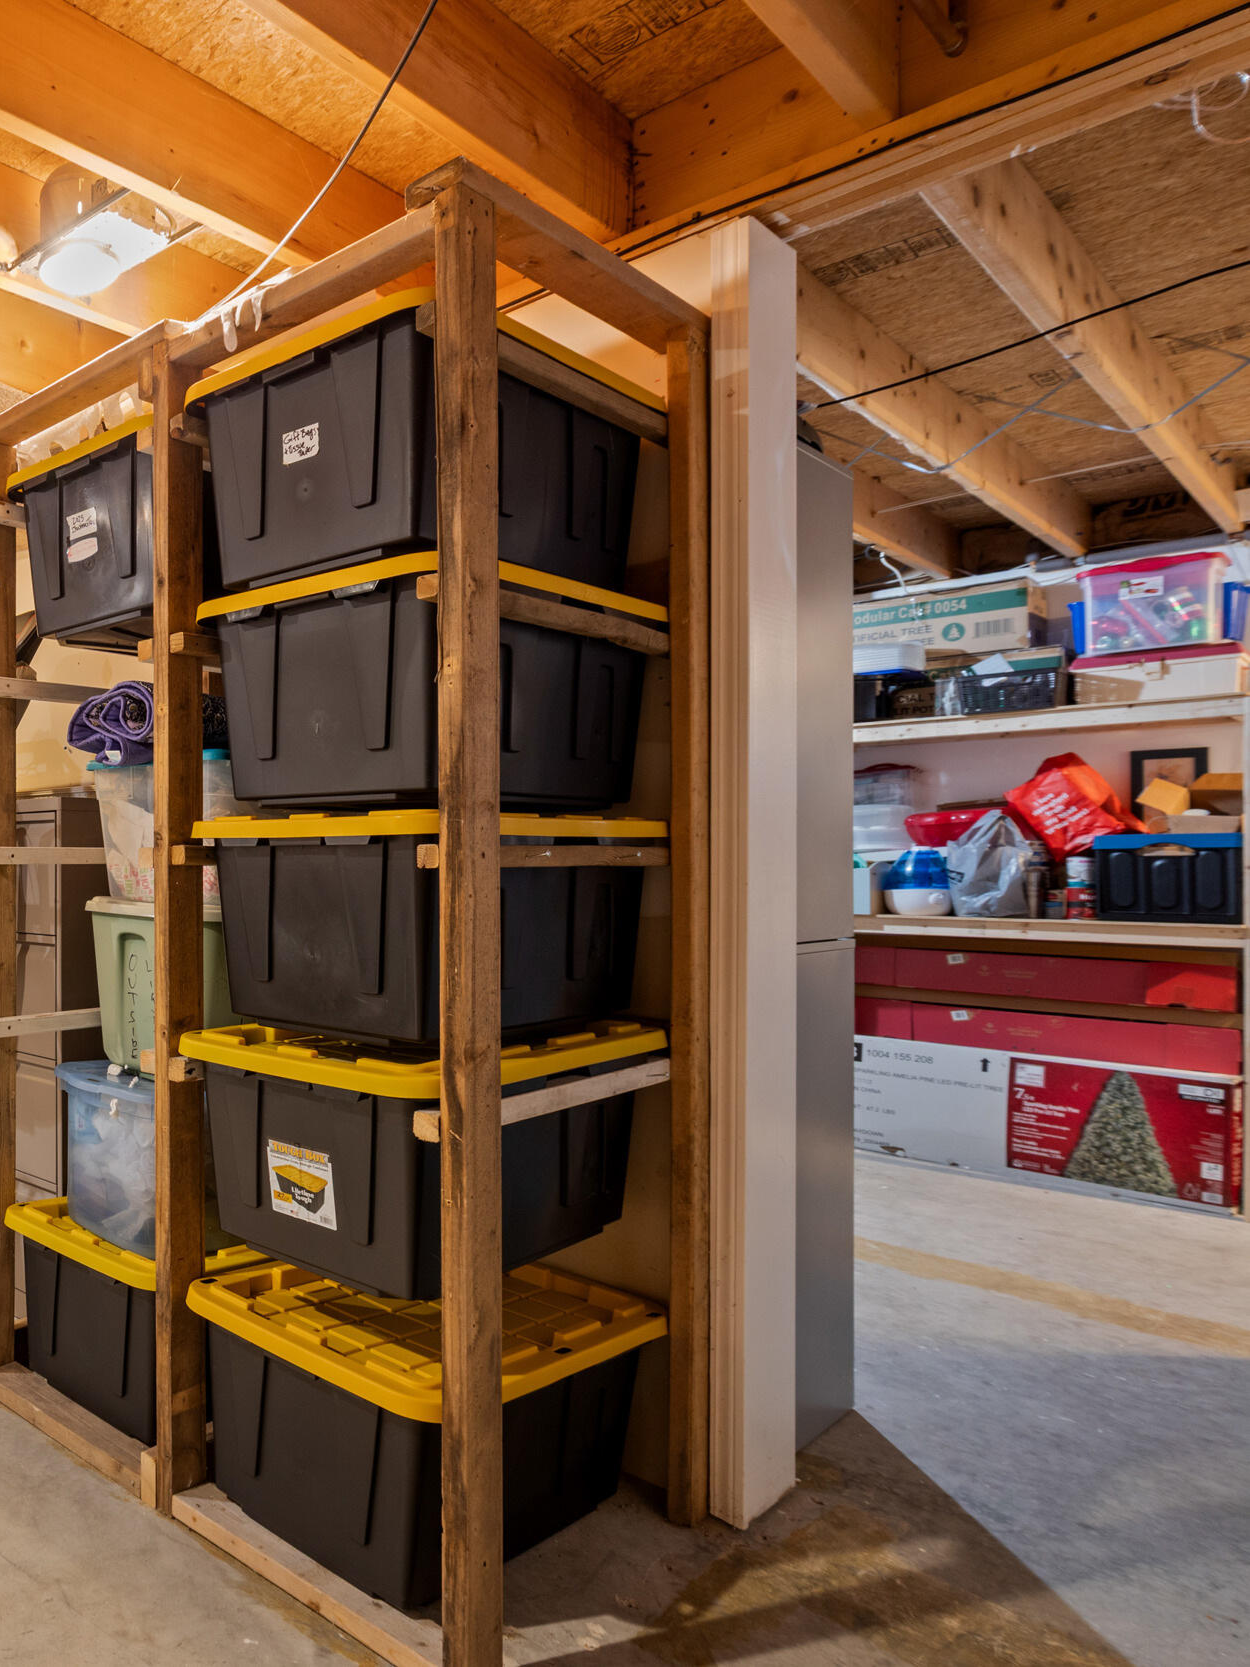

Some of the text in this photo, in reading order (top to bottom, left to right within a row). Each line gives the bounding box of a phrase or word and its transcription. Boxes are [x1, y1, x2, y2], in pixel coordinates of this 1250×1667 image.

[854, 611, 896, 625] odular
[934, 598, 967, 614] 0054
[901, 624, 934, 636] TREE
[866, 1049, 890, 1059] 1004
[893, 1052, 912, 1062] 155
[271, 1141, 303, 1160] TOUGH
[304, 1148, 327, 1165] BOX
[291, 1186, 316, 1200] Lifetime
[294, 1193, 313, 1206] Tough
